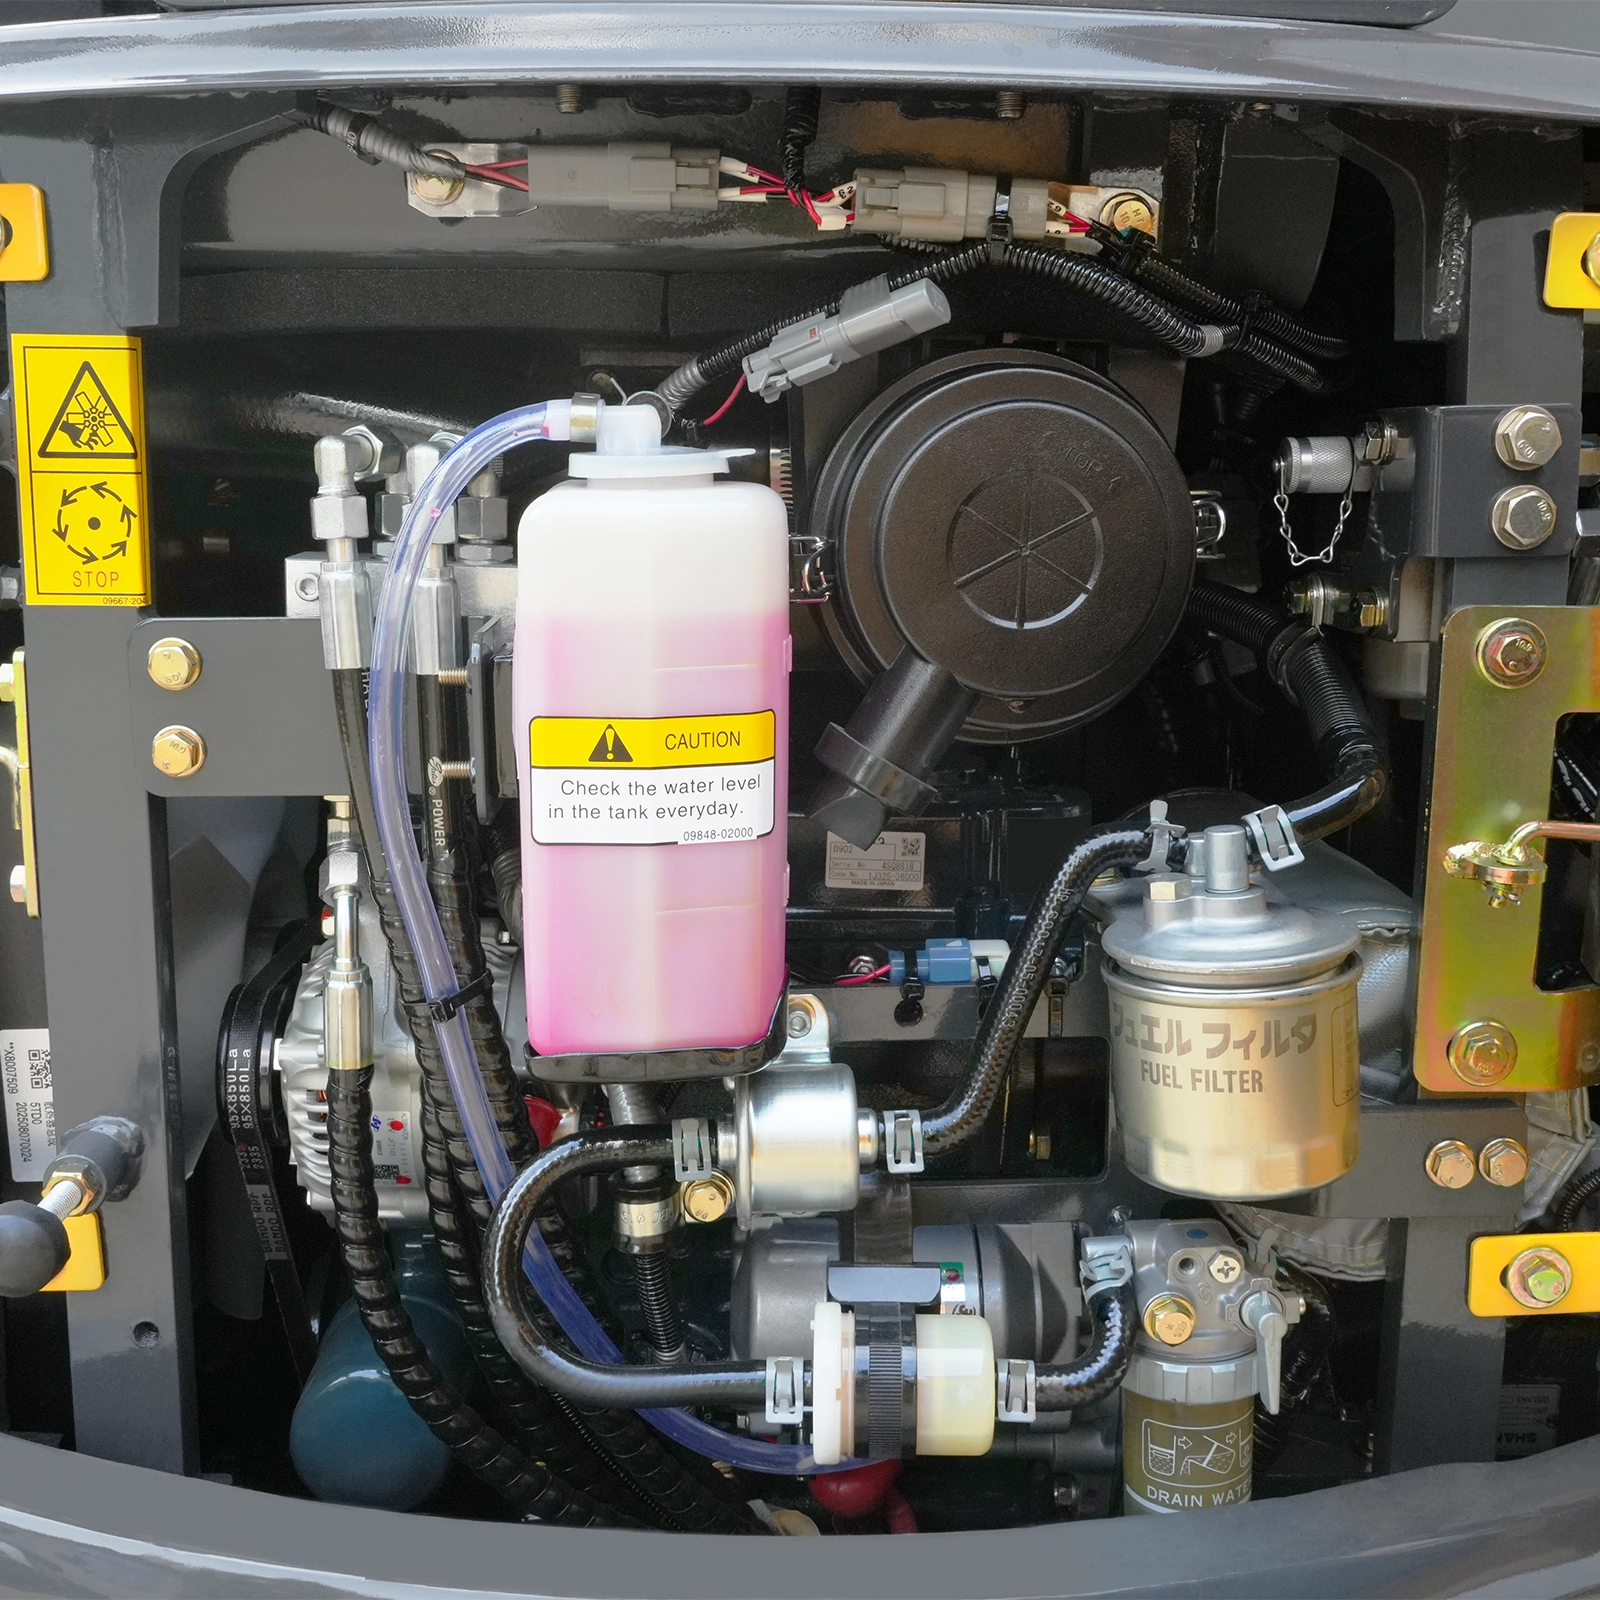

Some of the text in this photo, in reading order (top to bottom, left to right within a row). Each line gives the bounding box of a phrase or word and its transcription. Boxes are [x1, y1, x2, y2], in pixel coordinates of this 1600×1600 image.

[72, 570, 120, 588] STOP
[664, 730, 741, 751] CAUTION
[561, 774, 761, 796] Check the water level
[431, 799, 446, 837] POWER
[548, 801, 744, 820] in the tank everyday.
[683, 827, 754, 841] 09848-02000
[833, 845, 853, 853] D902
[1202, 1013, 1317, 1060] フィルタ
[1140, 1058, 1264, 1094] FUEL FILTER
[30, 1102, 42, 1125] 5TD0
[16, 1102, 32, 1162] 202508070024
[268, 1218, 286, 1253] BANDO
[1147, 1480, 1253, 1507] DRAIN WATE
